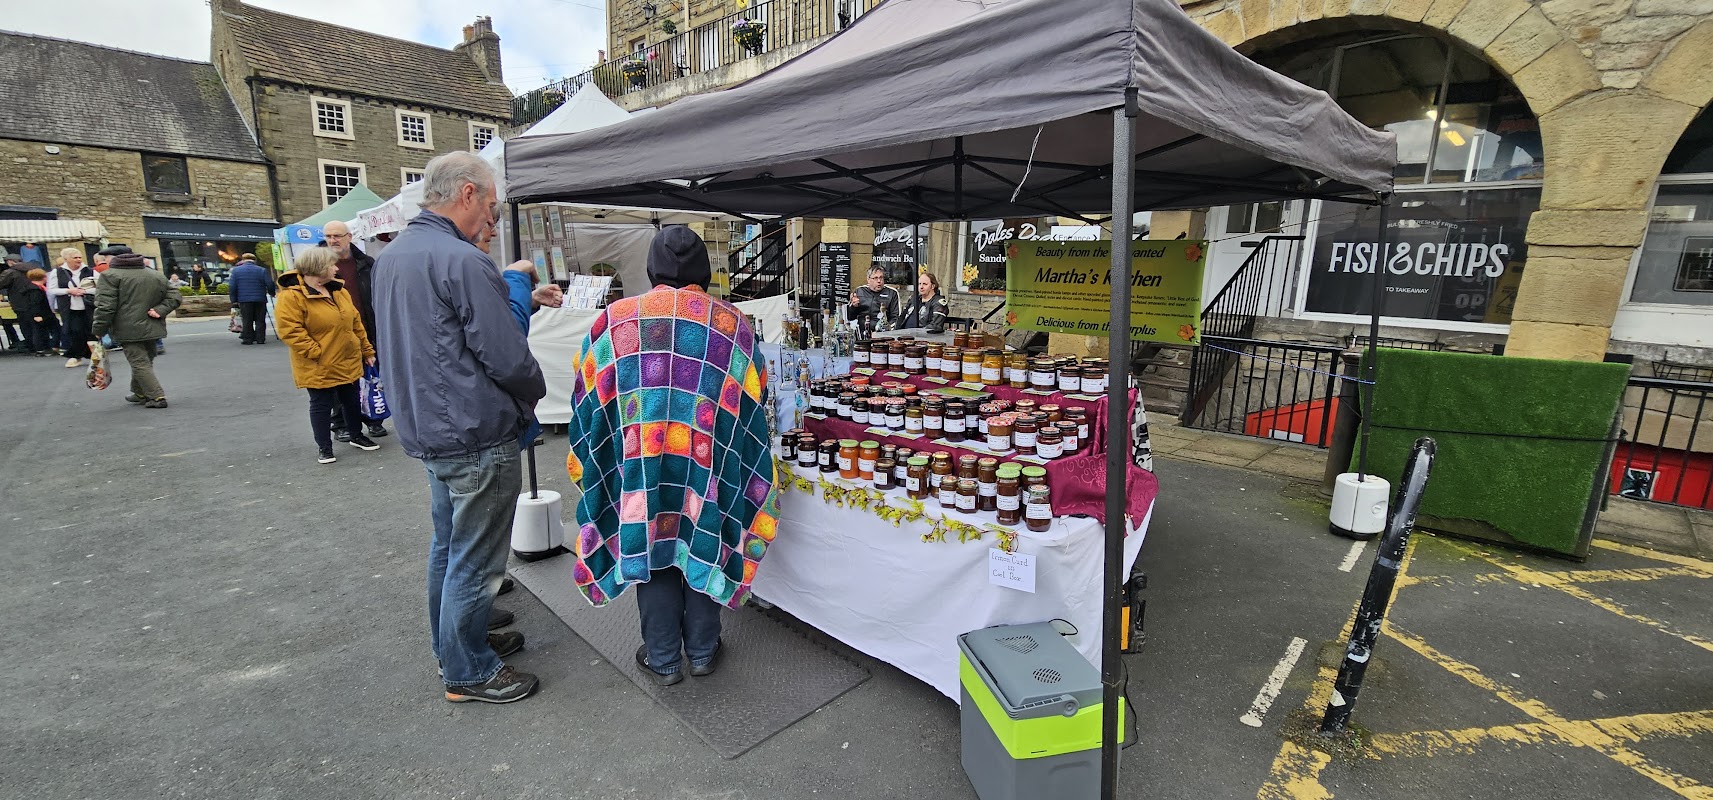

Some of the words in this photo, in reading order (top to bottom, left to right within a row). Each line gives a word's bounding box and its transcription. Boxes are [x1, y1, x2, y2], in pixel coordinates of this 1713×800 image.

[874, 227, 893, 247] ales
[975, 219, 1015, 251] Dales
[872, 253, 901, 263] andwich
[903, 254, 914, 263] Ba
[1035, 246, 1067, 260] Beauty
[1068, 246, 1090, 257] from
[1093, 246, 1109, 258] the
[1131, 246, 1167, 258] anted
[1034, 267, 1099, 285] Martha's
[1036, 316, 1075, 329] Delicious
[1077, 319, 1099, 331] from
[1102, 321, 1111, 331] th
